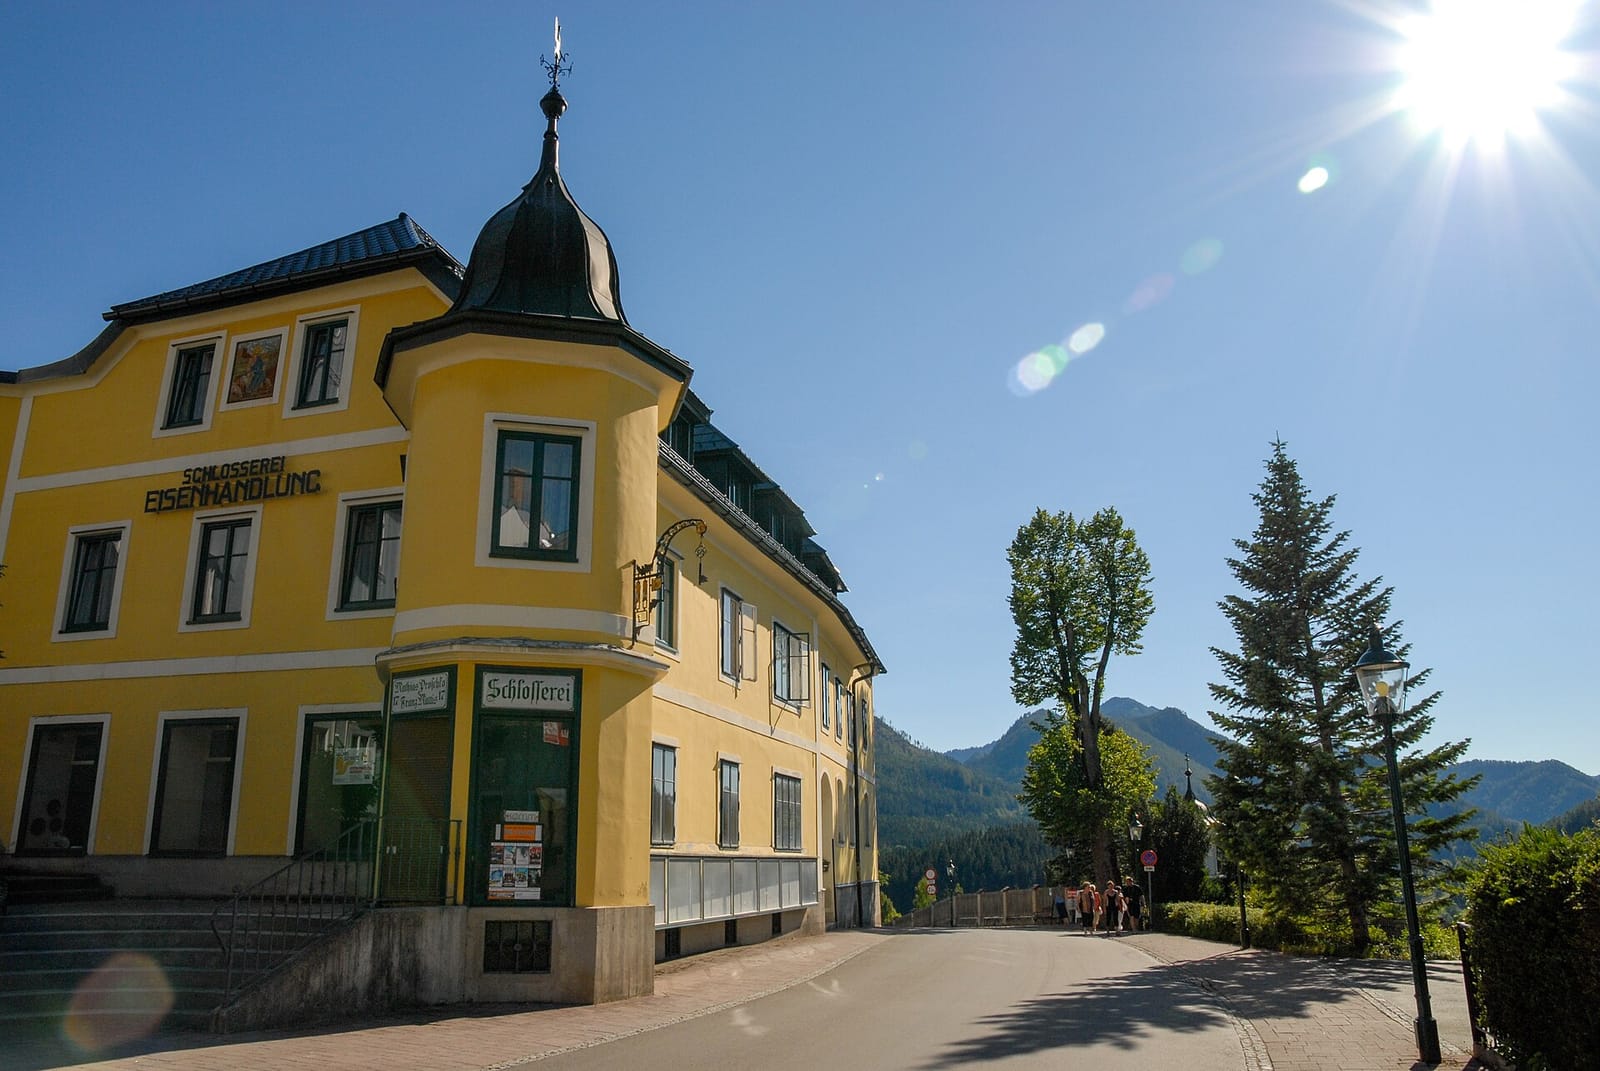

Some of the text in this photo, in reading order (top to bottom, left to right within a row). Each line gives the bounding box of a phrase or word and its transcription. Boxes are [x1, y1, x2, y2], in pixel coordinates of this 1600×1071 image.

[182, 456, 286, 485] SCHLOSSEREI
[144, 470, 321, 514] EISENHANDLUNG
[487, 679, 570, 704] Schlosserei
